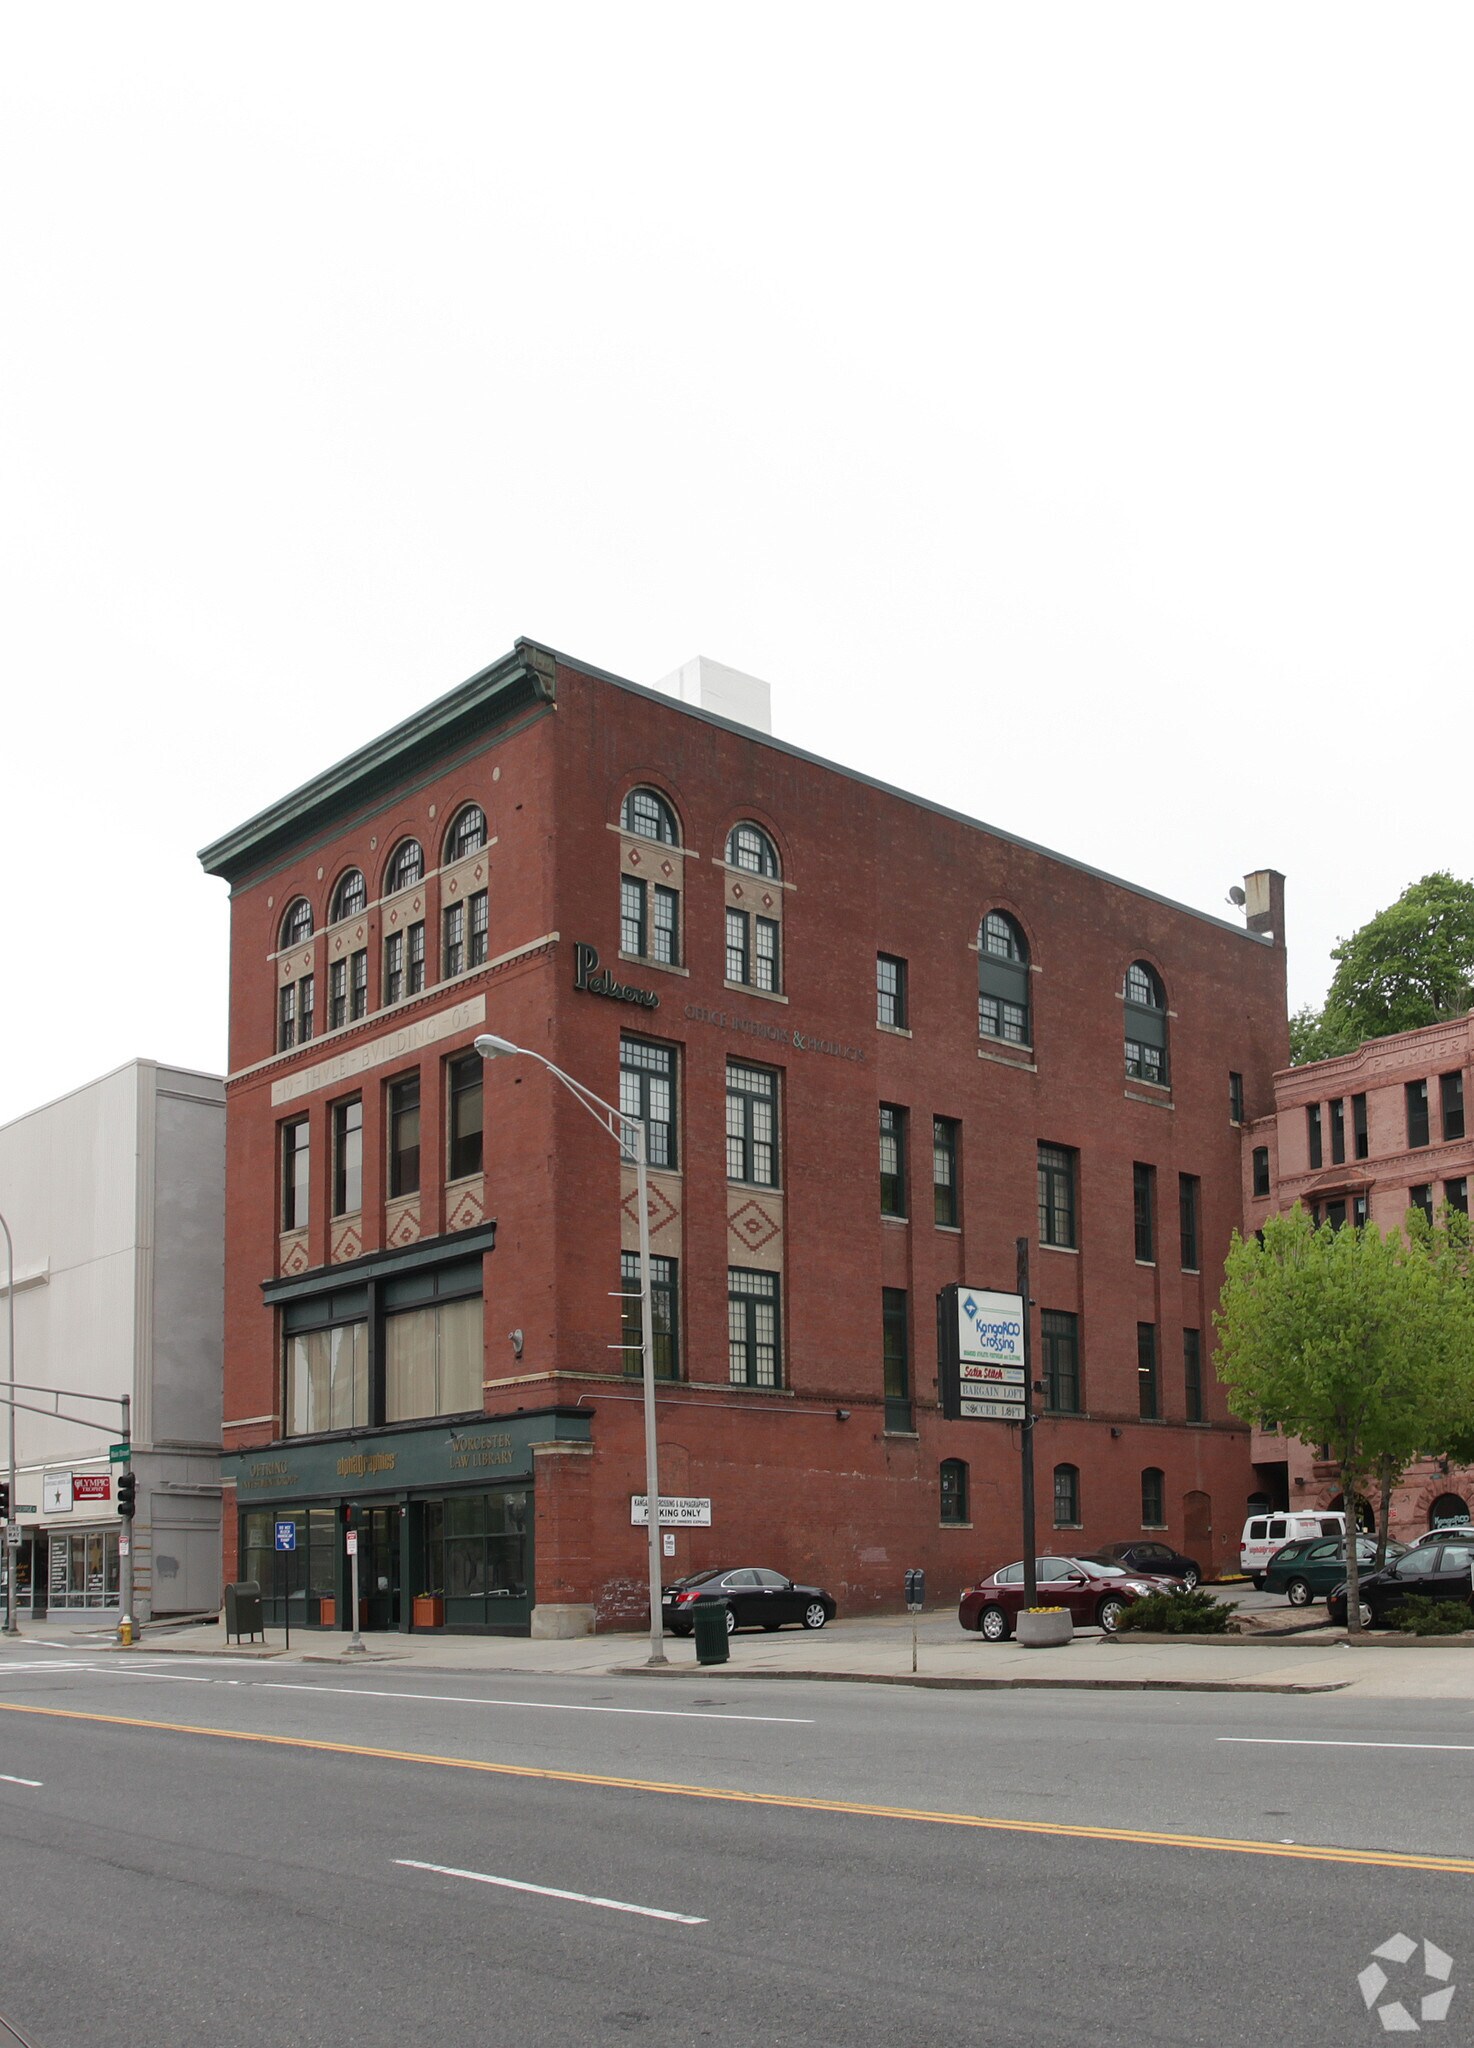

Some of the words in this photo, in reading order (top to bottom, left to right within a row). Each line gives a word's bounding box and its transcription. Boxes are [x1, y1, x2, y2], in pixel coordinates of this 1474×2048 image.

[684, 1005, 727, 1028] OFFICE
[732, 1017, 789, 1043] INTERIORS
[793, 1031, 805, 1049] &
[808, 1039, 866, 1062] PRODUCTS
[963, 1384, 999, 1397] BARGAIN
[1003, 1390, 1023, 1399] LOFT
[965, 1404, 997, 1415] SOCCER
[1002, 1407, 1021, 1417] LOFT
[451, 1433, 512, 1452] WORCESTER
[337, 1453, 395, 1479] alphagraphics
[449, 1455, 470, 1470] LAW
[473, 1450, 514, 1467] LIBRARY
[74, 1479, 109, 1490] OLYMPIC
[644, 1509, 678, 1517] PKING
[681, 1509, 701, 1517] ONLY
